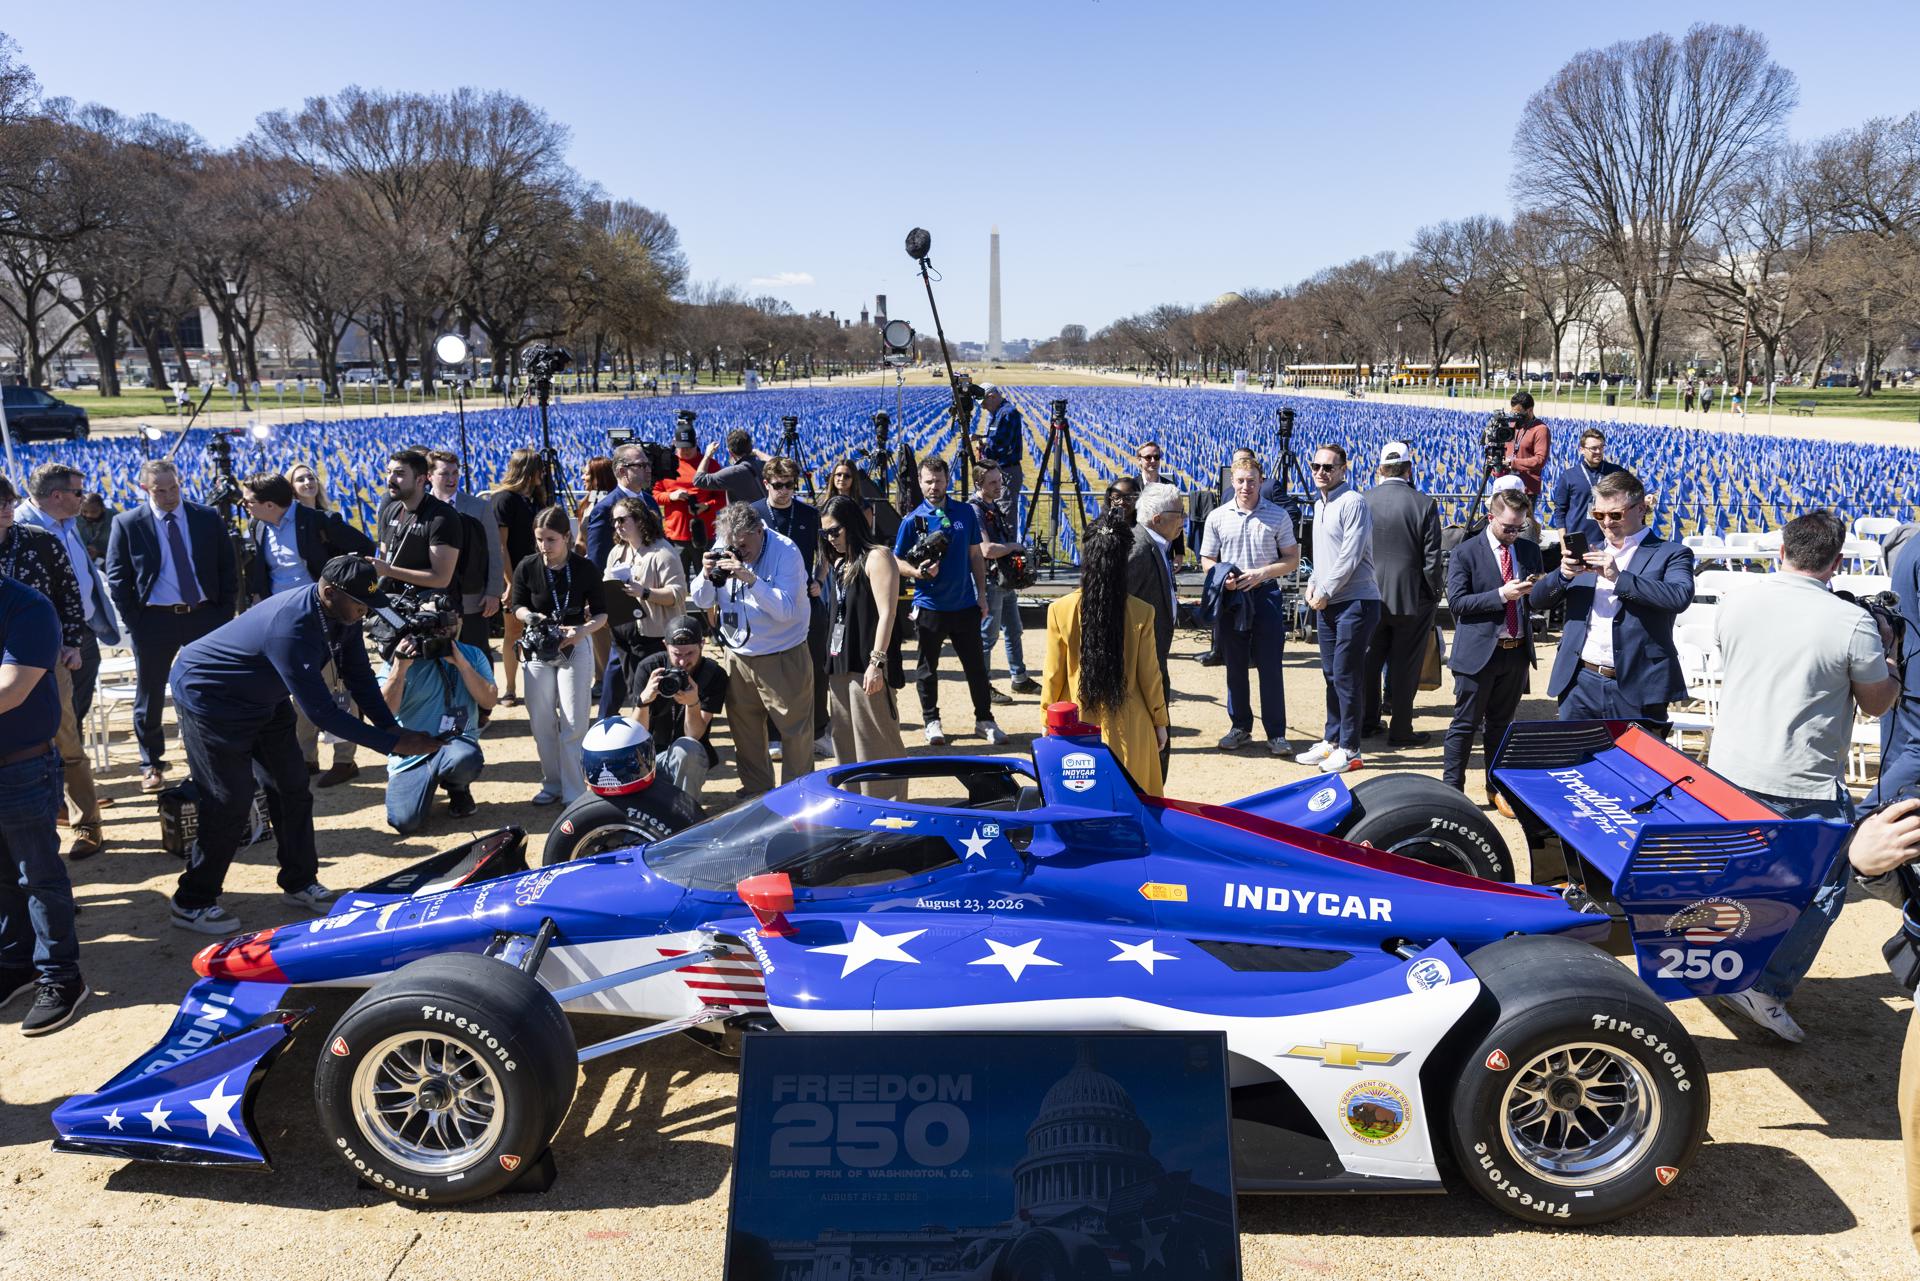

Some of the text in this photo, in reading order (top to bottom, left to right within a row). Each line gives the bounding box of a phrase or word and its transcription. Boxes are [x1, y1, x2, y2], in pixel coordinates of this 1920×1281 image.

[1062, 769, 1096, 777] INDYCAR
[1547, 769, 1639, 825] Freedom
[1430, 817, 1502, 873] Firestone
[916, 897, 1024, 912] August 23, 2026
[1223, 882, 1393, 922] INDYCAR
[1708, 896, 1720, 904] OF
[1722, 897, 1751, 939] TRANSPORTATION
[741, 927, 775, 975] Firestone
[1657, 948, 1744, 981] 250
[1419, 963, 1446, 989] FOX
[421, 1005, 517, 1072] Firestone
[1591, 1014, 1691, 1092] Firestone
[772, 1074, 973, 1101] FREEDOM
[1342, 1081, 1376, 1104] DEPARTMENT
[1388, 1085, 1400, 1095] THE
[1399, 1095, 1411, 1121] INTERIOR
[769, 1102, 970, 1168] 250
[1352, 1131, 1375, 1144] MARCH
[336, 1137, 430, 1200] Firestone
[769, 1169, 974, 1180] GRAND PRIX OF WASHINGTON, D.C.
[1474, 1142, 1572, 1218] Firestone
